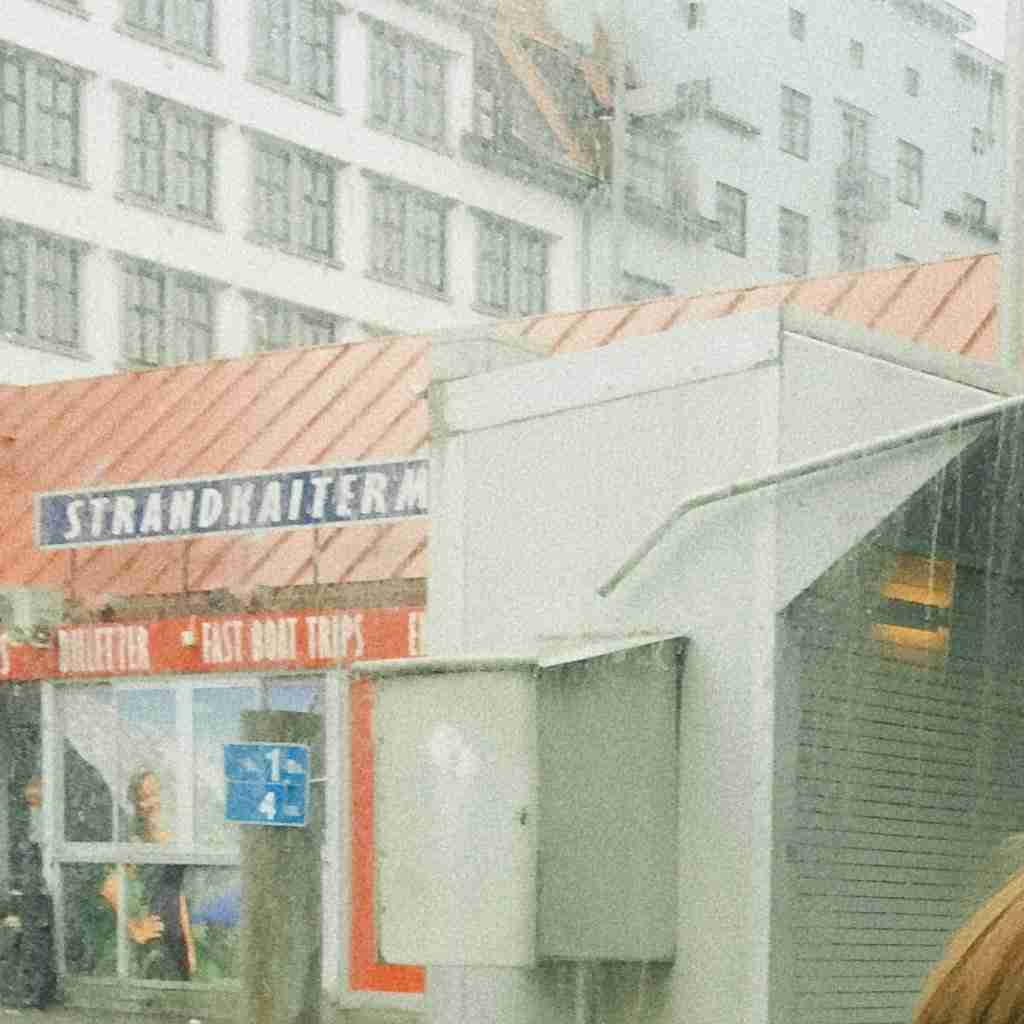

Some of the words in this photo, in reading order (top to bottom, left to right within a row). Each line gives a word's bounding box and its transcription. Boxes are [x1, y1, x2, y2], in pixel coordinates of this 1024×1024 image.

[202, 619, 244, 664] FAST
[251, 617, 298, 661] BOAT
[305, 613, 364, 659] TRIPS
[258, 791, 277, 820] 4
